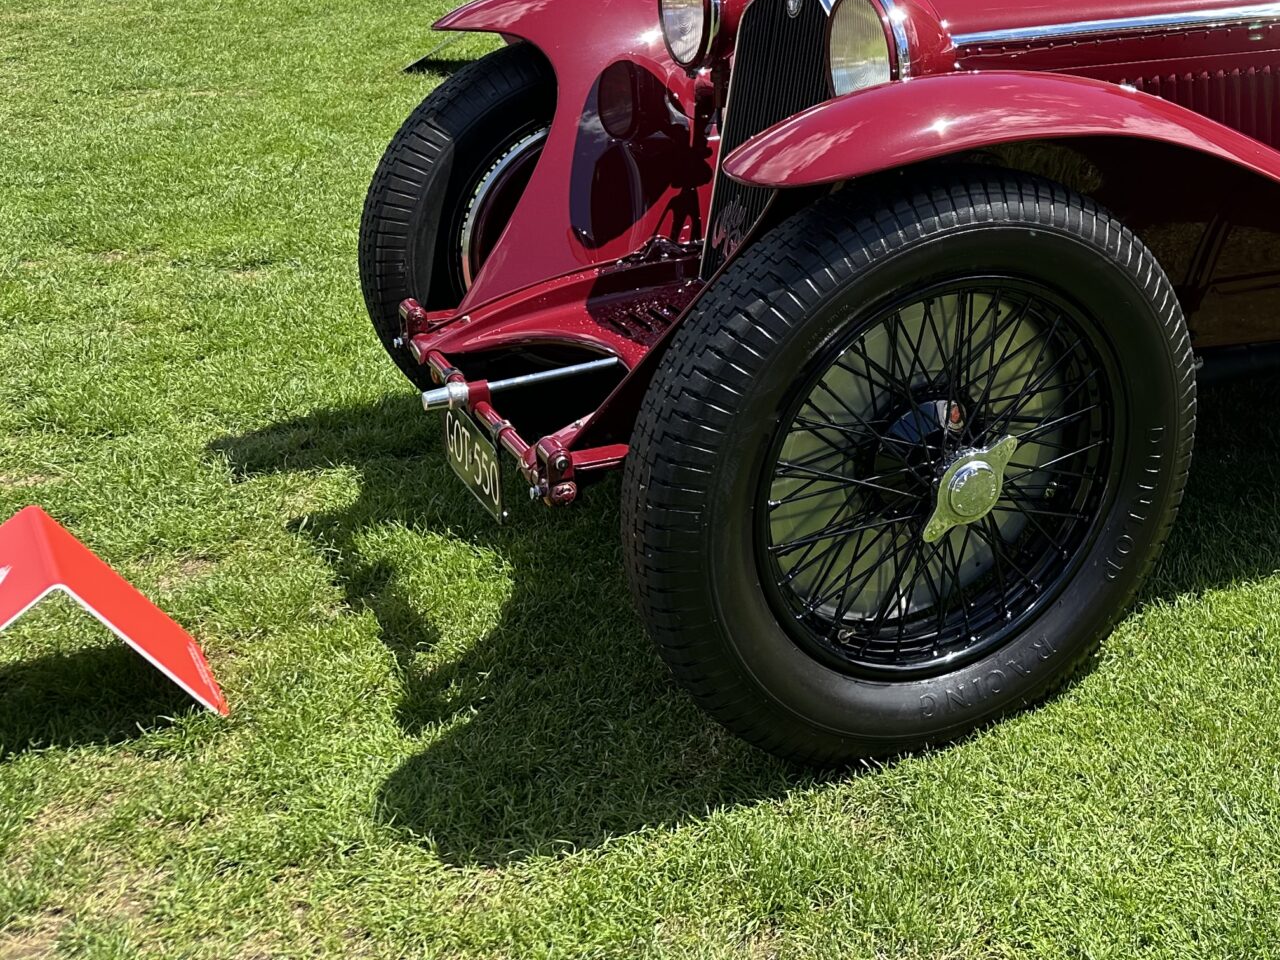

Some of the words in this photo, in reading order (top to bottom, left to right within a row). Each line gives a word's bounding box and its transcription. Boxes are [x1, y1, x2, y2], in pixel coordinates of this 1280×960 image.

[445, 410, 471, 471] GOT
[473, 443, 500, 506] 550
[1103, 425, 1168, 583] DUNLOP
[918, 633, 1058, 718] RACING
